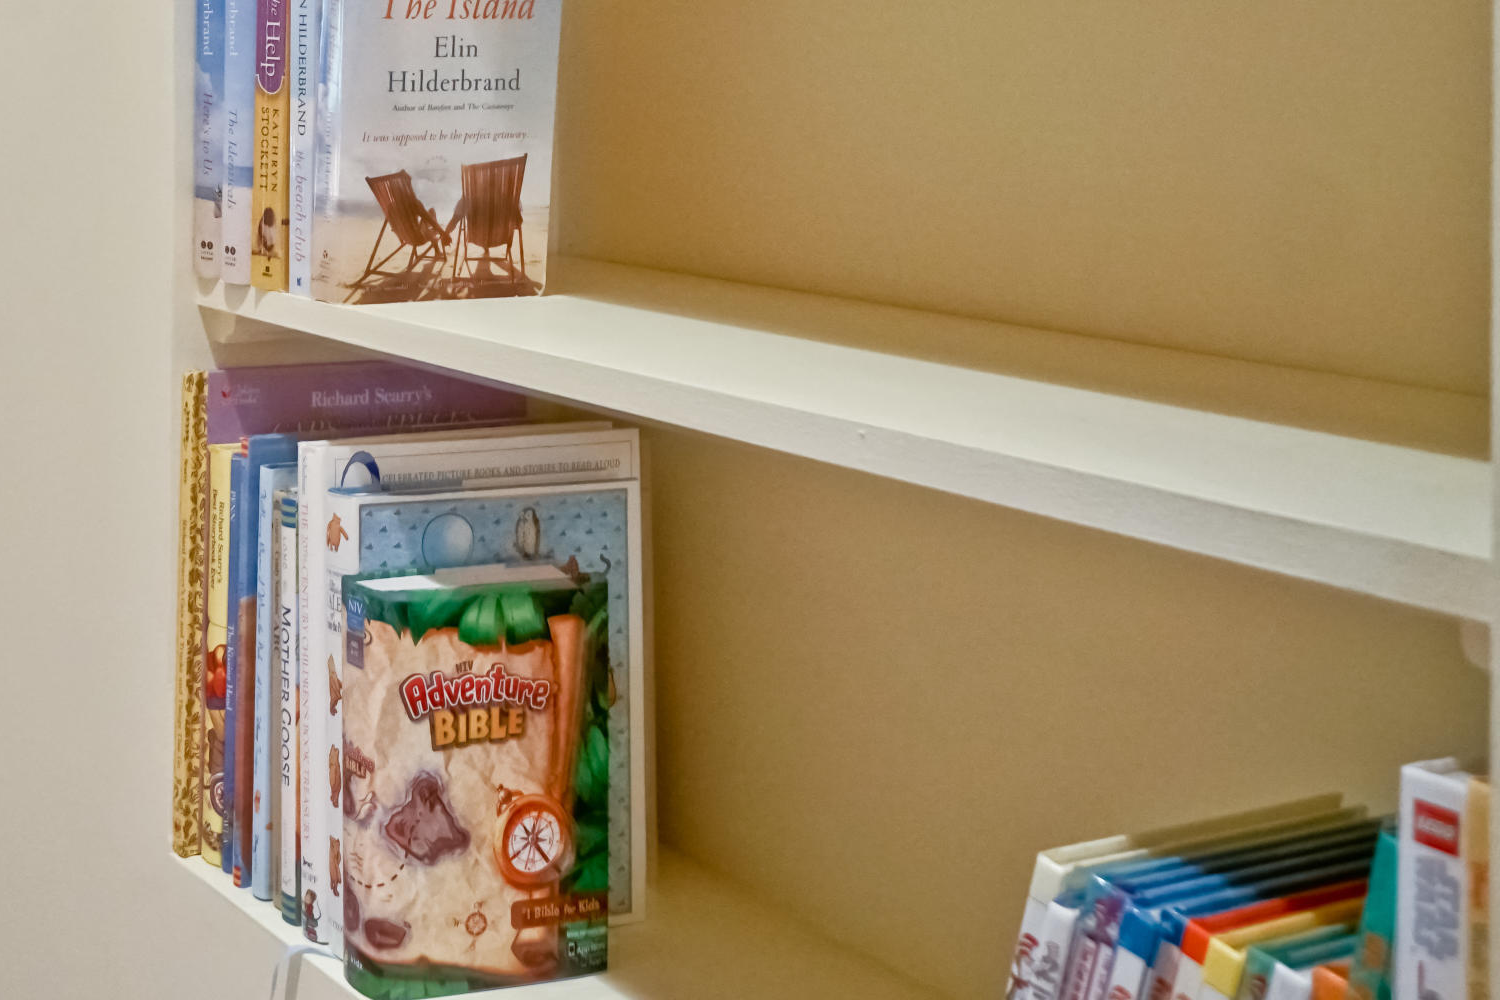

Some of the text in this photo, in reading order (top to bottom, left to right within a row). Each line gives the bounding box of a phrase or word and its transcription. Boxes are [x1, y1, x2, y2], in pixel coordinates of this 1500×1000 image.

[260, 19, 281, 77] Help
[433, 35, 479, 58] Elin
[297, 13, 308, 137] HILDERBRAND
[387, 68, 521, 93] Hilderbrand
[392, 104, 416, 112] Author
[418, 104, 426, 112] of
[453, 103, 465, 111] and
[468, 103, 480, 111] The
[202, 92, 213, 176] Here's to Us
[227, 109, 238, 135] The
[260, 106, 270, 193] STOCKETT
[362, 131, 371, 143] It
[373, 134, 389, 142] was
[392, 130, 428, 146] supposed
[430, 131, 437, 141] to
[439, 130, 449, 141] be
[450, 129, 463, 140] the
[463, 129, 490, 144] perfect
[270, 107, 280, 194] KATHRYN
[294, 150, 307, 262] the beach club
[311, 386, 433, 408] Richard Scarry's
[382, 458, 621, 482] CELEBRATED PICTURE BOOKS AND STORIES TO READ ALOUD
[348, 599, 363, 615] NIV
[227, 624, 235, 644] The
[455, 659, 474, 674] NIV
[281, 604, 292, 787] MOTHER GOOSE
[401, 662, 550, 721] Adventure
[431, 706, 525, 748] BIBLE
[534, 903, 560, 919] Bible
[563, 902, 577, 915] for
[578, 897, 600, 913] Kids
